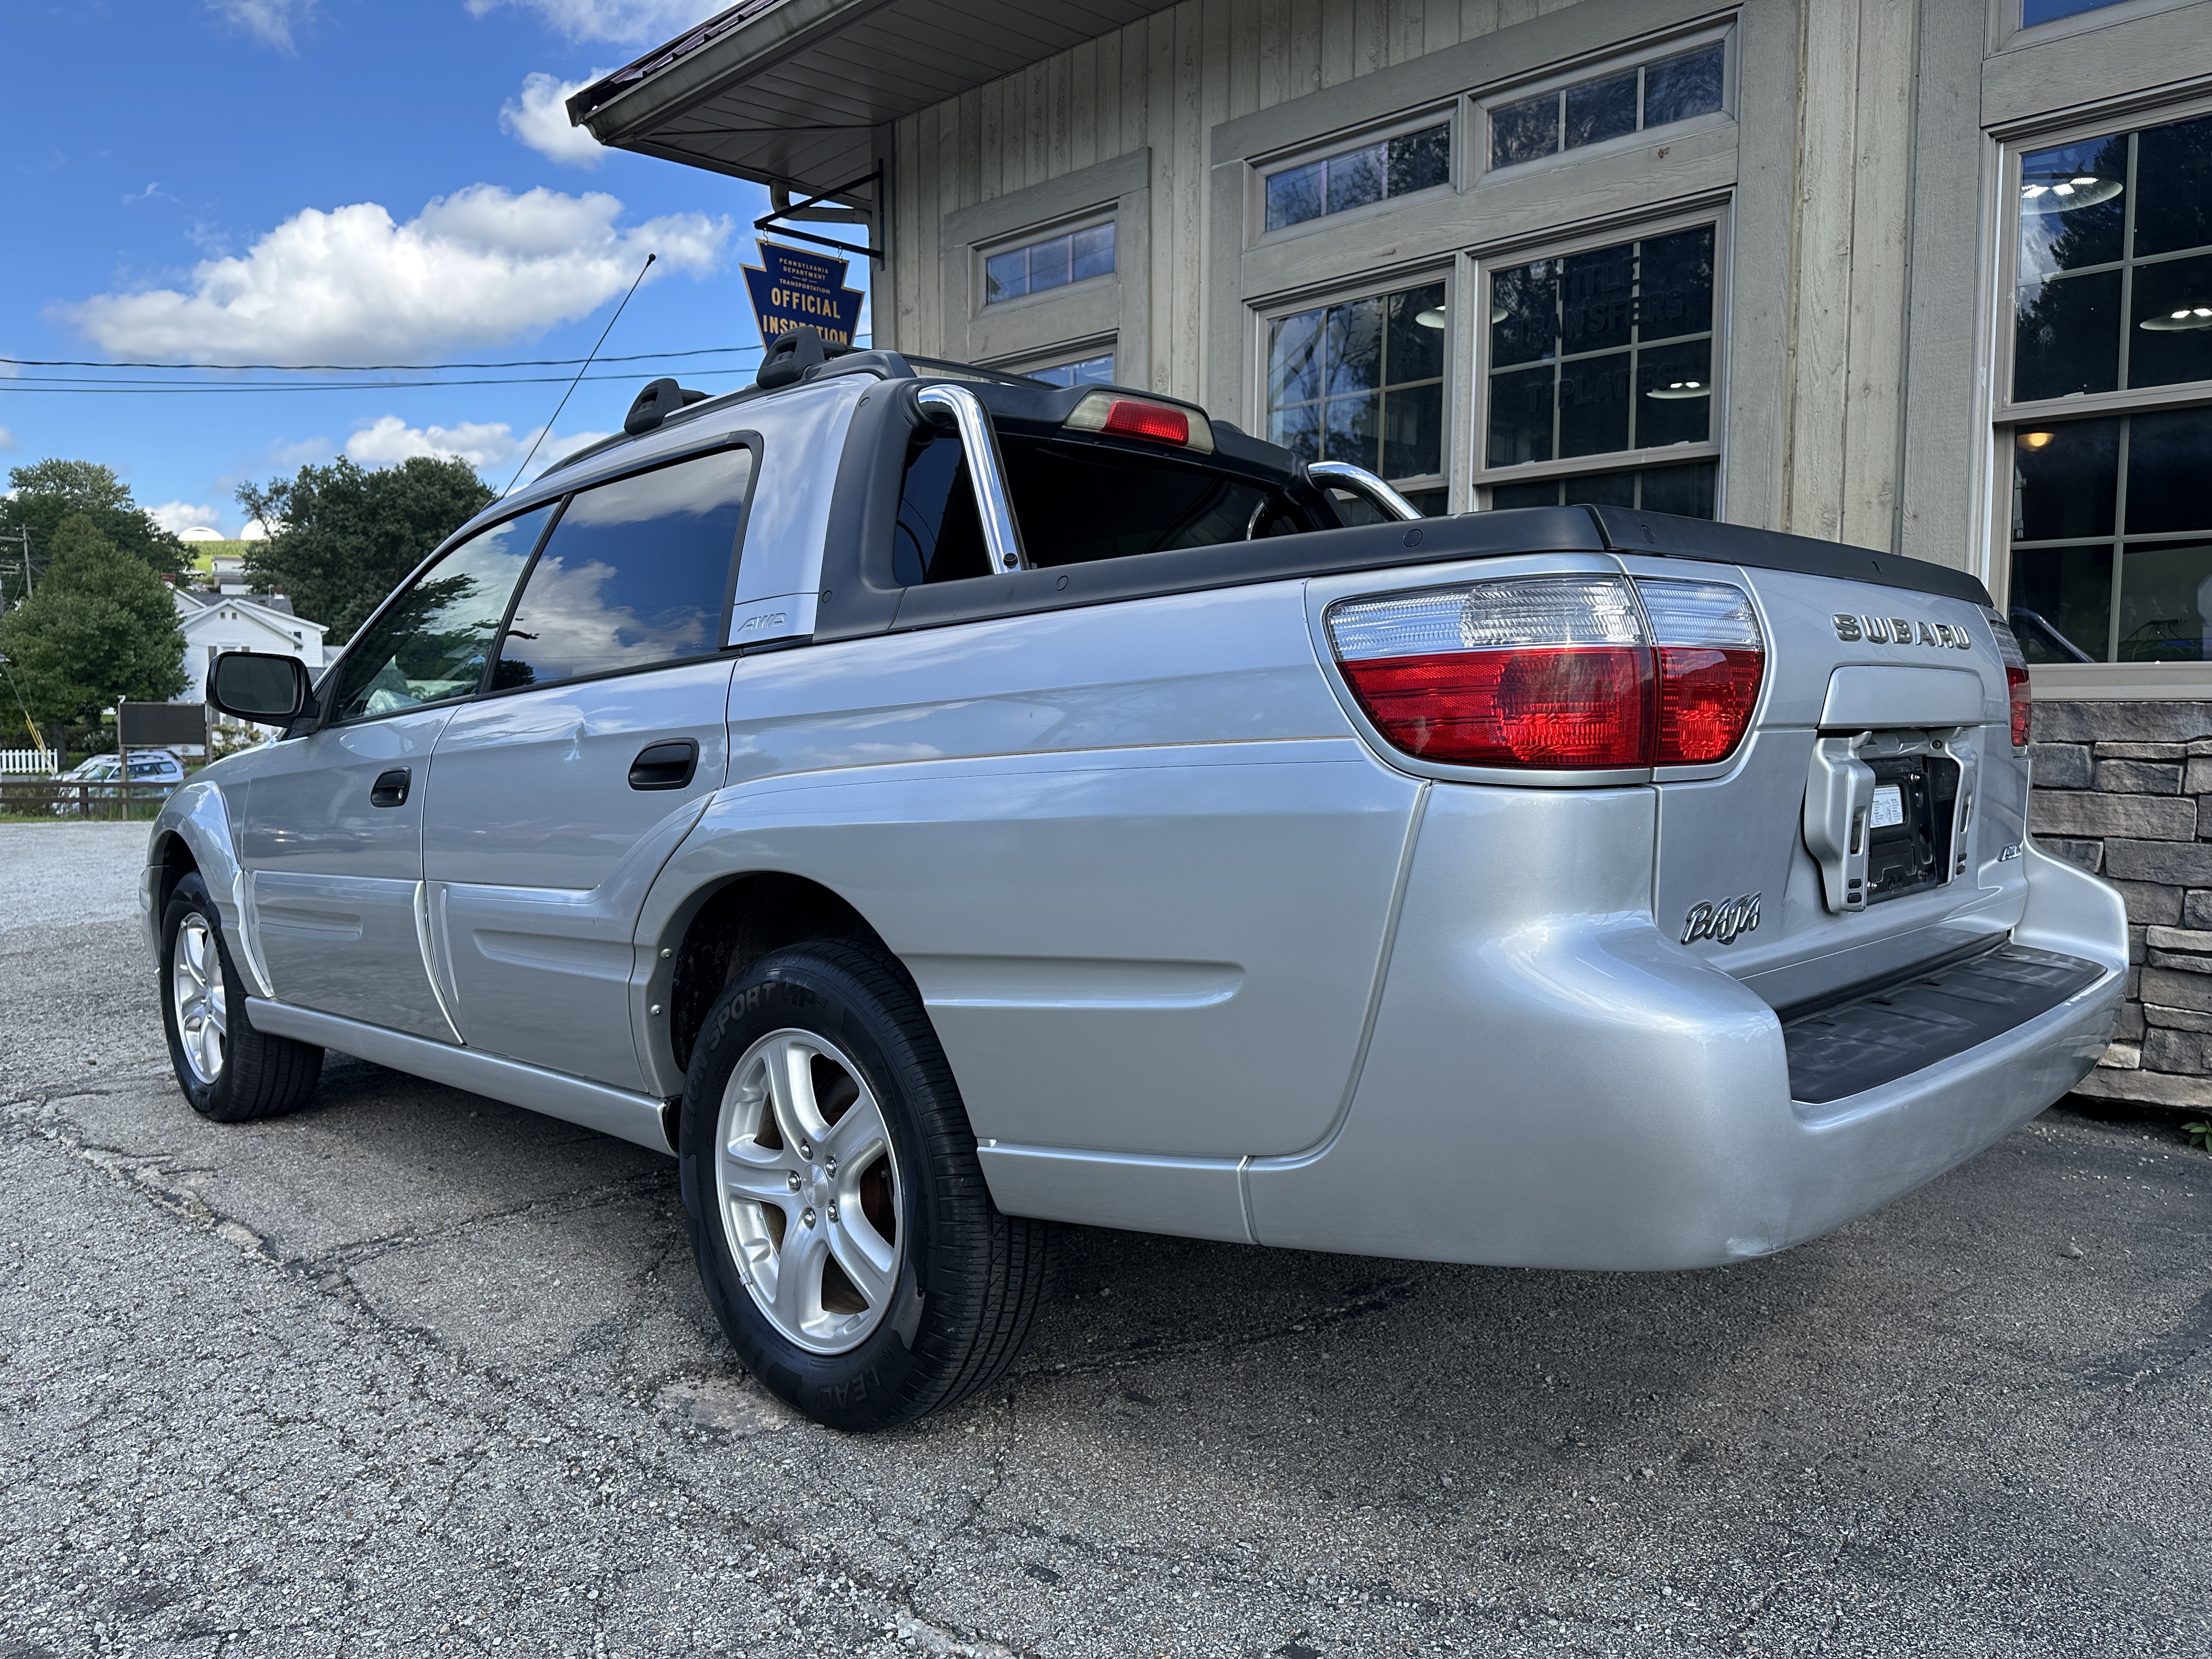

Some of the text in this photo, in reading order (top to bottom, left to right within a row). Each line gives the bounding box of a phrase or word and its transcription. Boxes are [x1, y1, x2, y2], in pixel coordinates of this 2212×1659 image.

[779, 258, 829, 274] PENNSYLVANIA
[783, 266, 826, 280] DEPARTMENT
[1555, 256, 1639, 300] TITLE
[779, 278, 830, 294] TRANSPORTATION
[771, 287, 841, 319] OFFICIAL
[1513, 289, 1684, 346] TRANSFERS
[763, 314, 848, 345] INSPTION
[737, 612, 788, 633] AWD
[1832, 613, 1972, 650] SUBARU
[1680, 891, 1762, 945] BAJA
[707, 982, 777, 1051] SPORT
